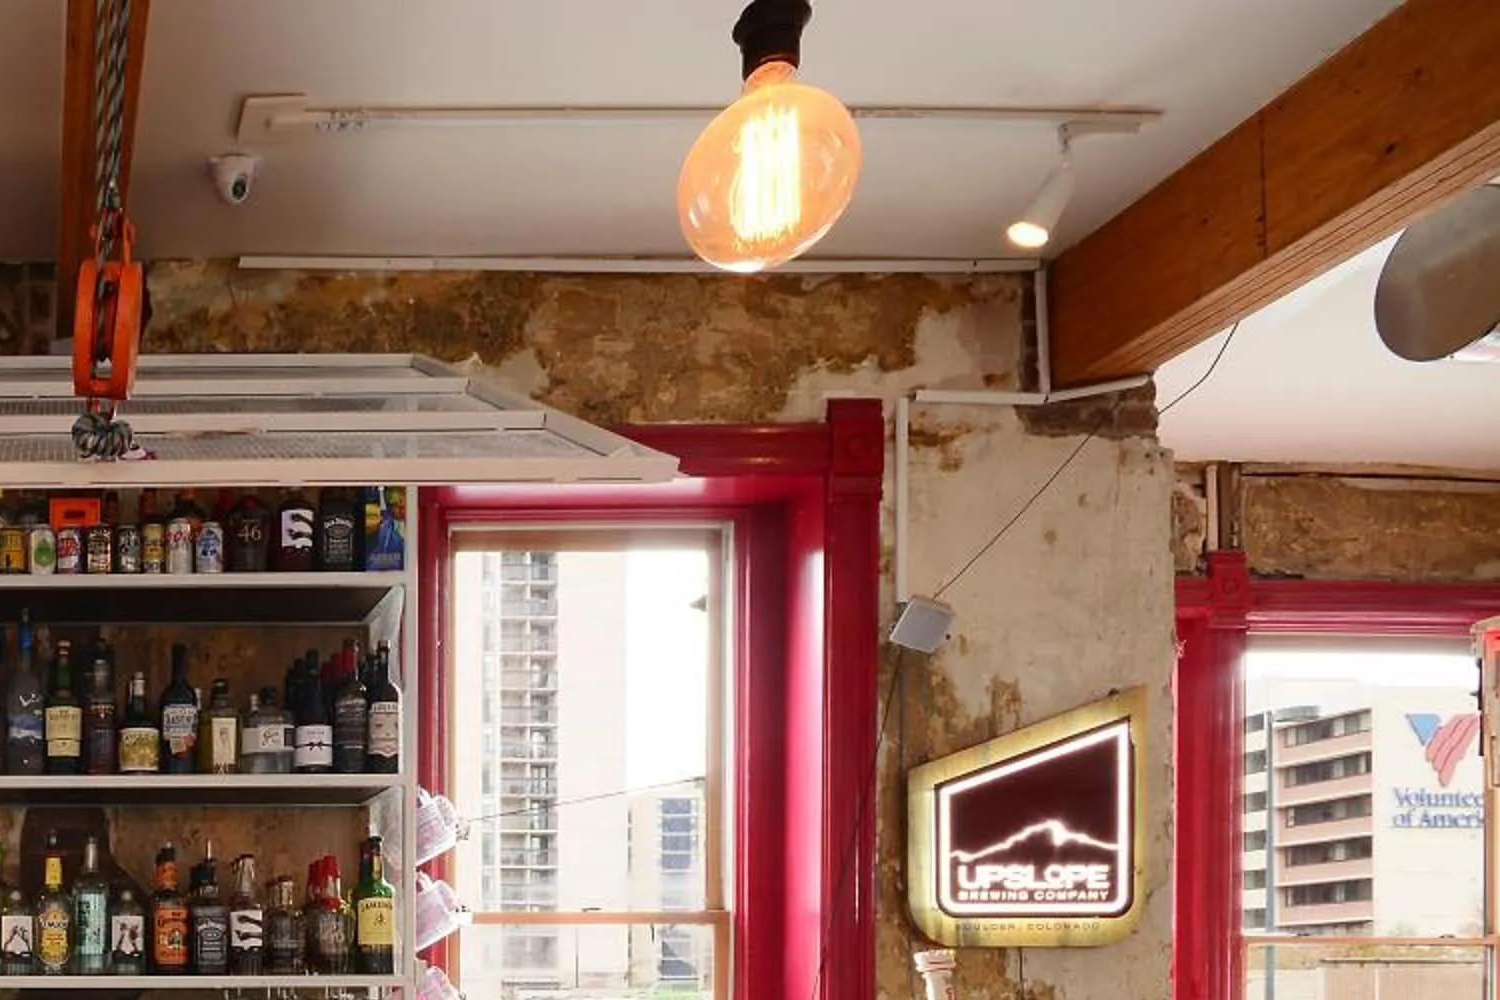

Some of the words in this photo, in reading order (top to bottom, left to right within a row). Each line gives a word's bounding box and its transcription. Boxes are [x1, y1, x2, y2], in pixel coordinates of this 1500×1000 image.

[1393, 787, 1484, 807] Voluntee
[1393, 808, 1415, 828] of
[1421, 810, 1484, 828] Ameri
[957, 864, 1110, 889] UPSLOPE
[958, 891, 1029, 901] BREWING
[1034, 891, 1109, 901] COMPANY
[1028, 921, 1100, 931] COLORADO
